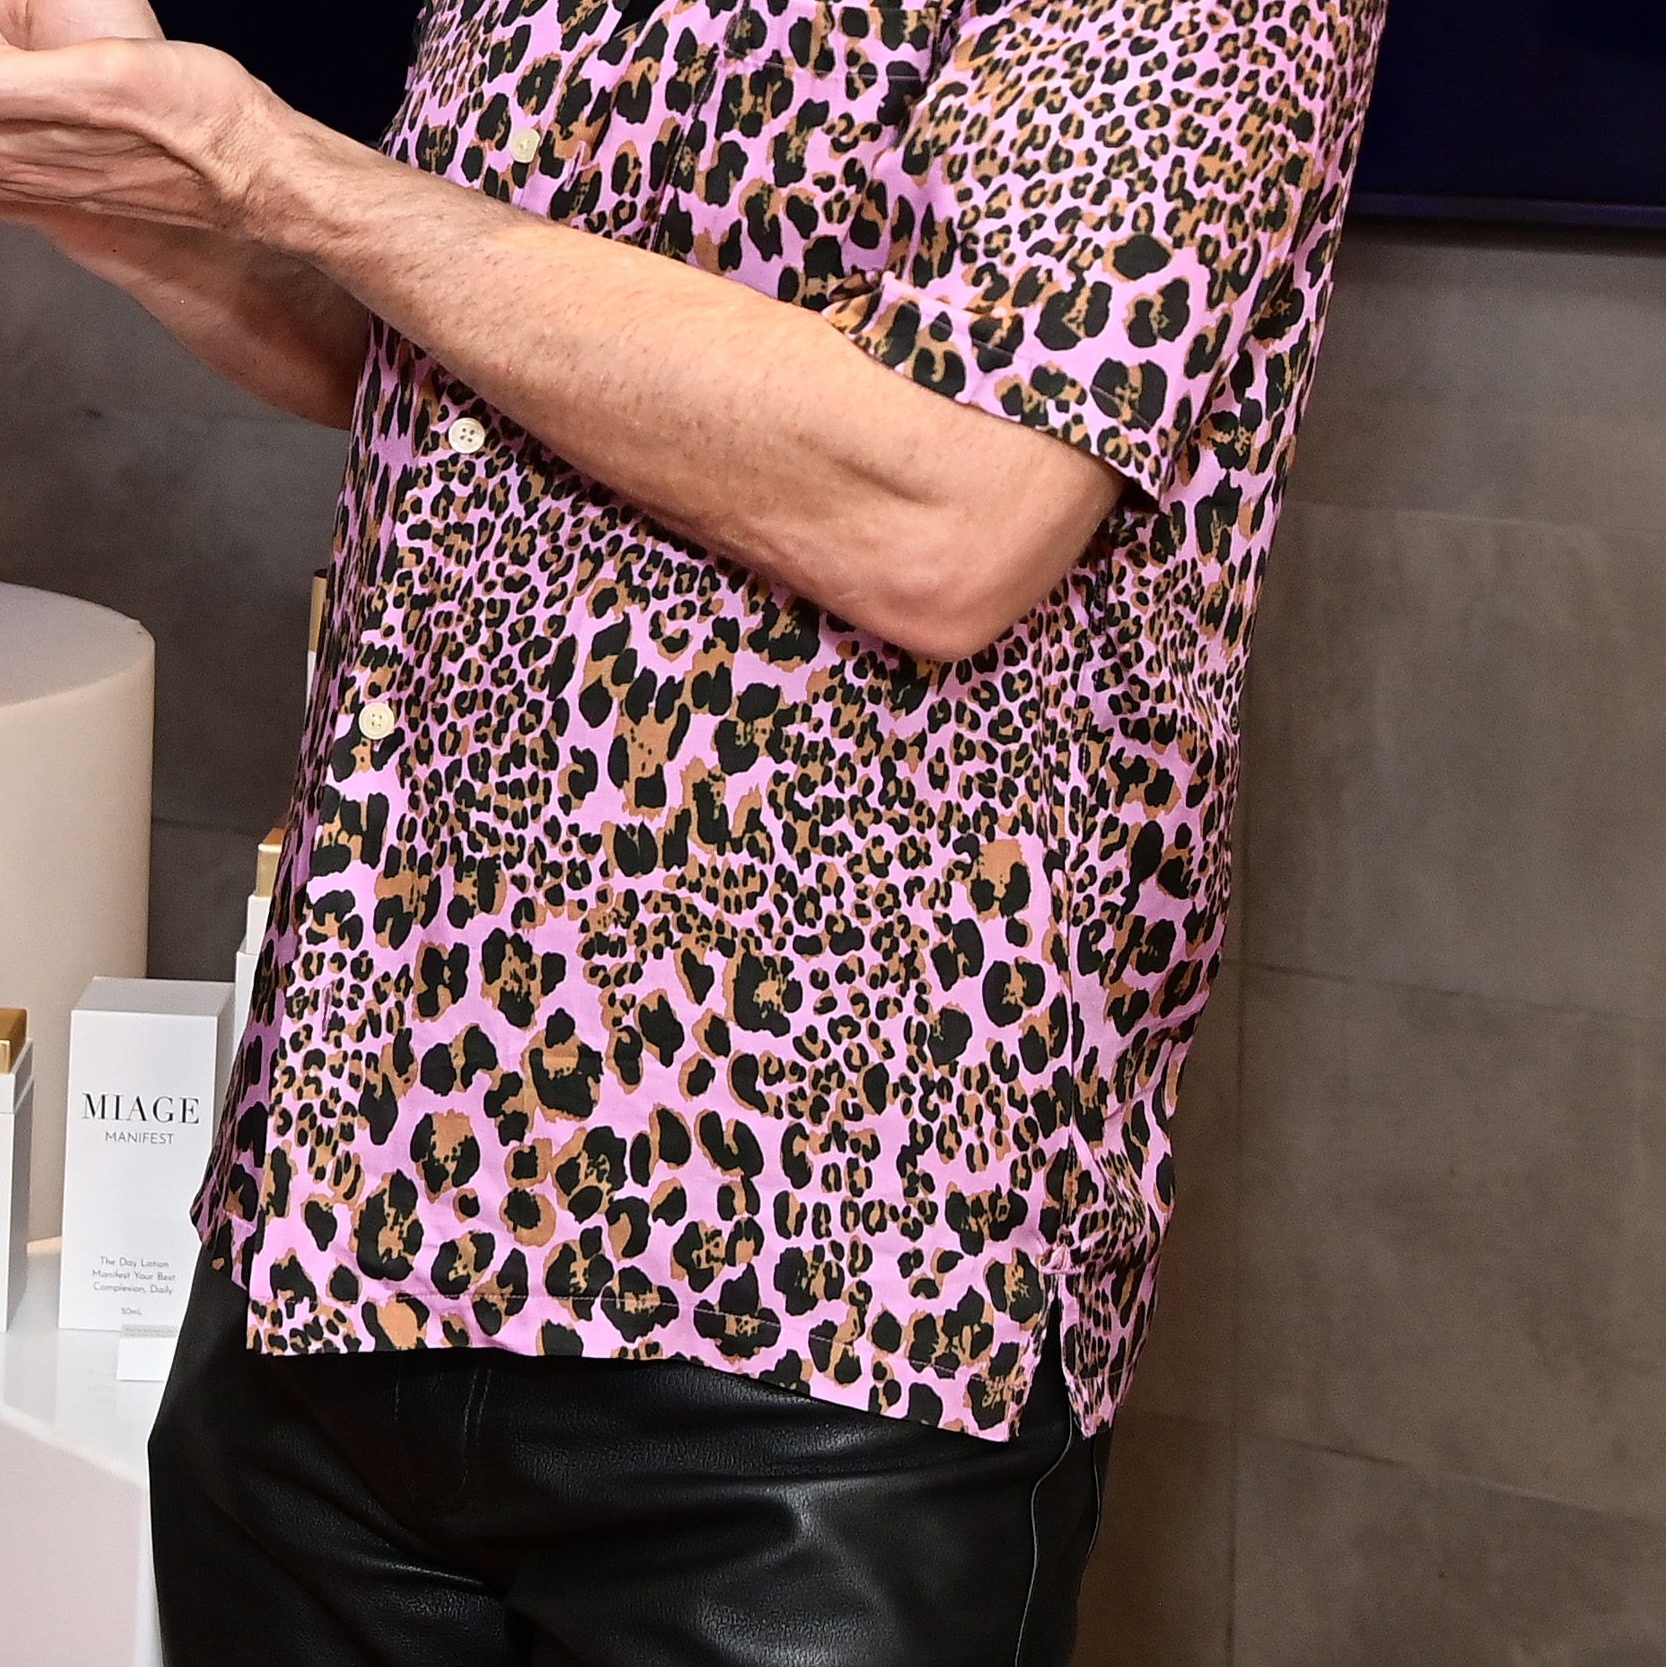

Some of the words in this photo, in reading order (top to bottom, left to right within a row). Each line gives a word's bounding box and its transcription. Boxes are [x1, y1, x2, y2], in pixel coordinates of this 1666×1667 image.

[81, 1092, 201, 1125] MIAGE
[104, 1131, 175, 1145] MANIFEST
[99, 1256, 116, 1267] The
[119, 1257, 138, 1269] Day
[140, 1259, 170, 1269] Lotion
[91, 1269, 131, 1280] Manifest
[134, 1271, 154, 1281] Your
[157, 1272, 177, 1282] Best
[149, 1283, 174, 1296] Daily
